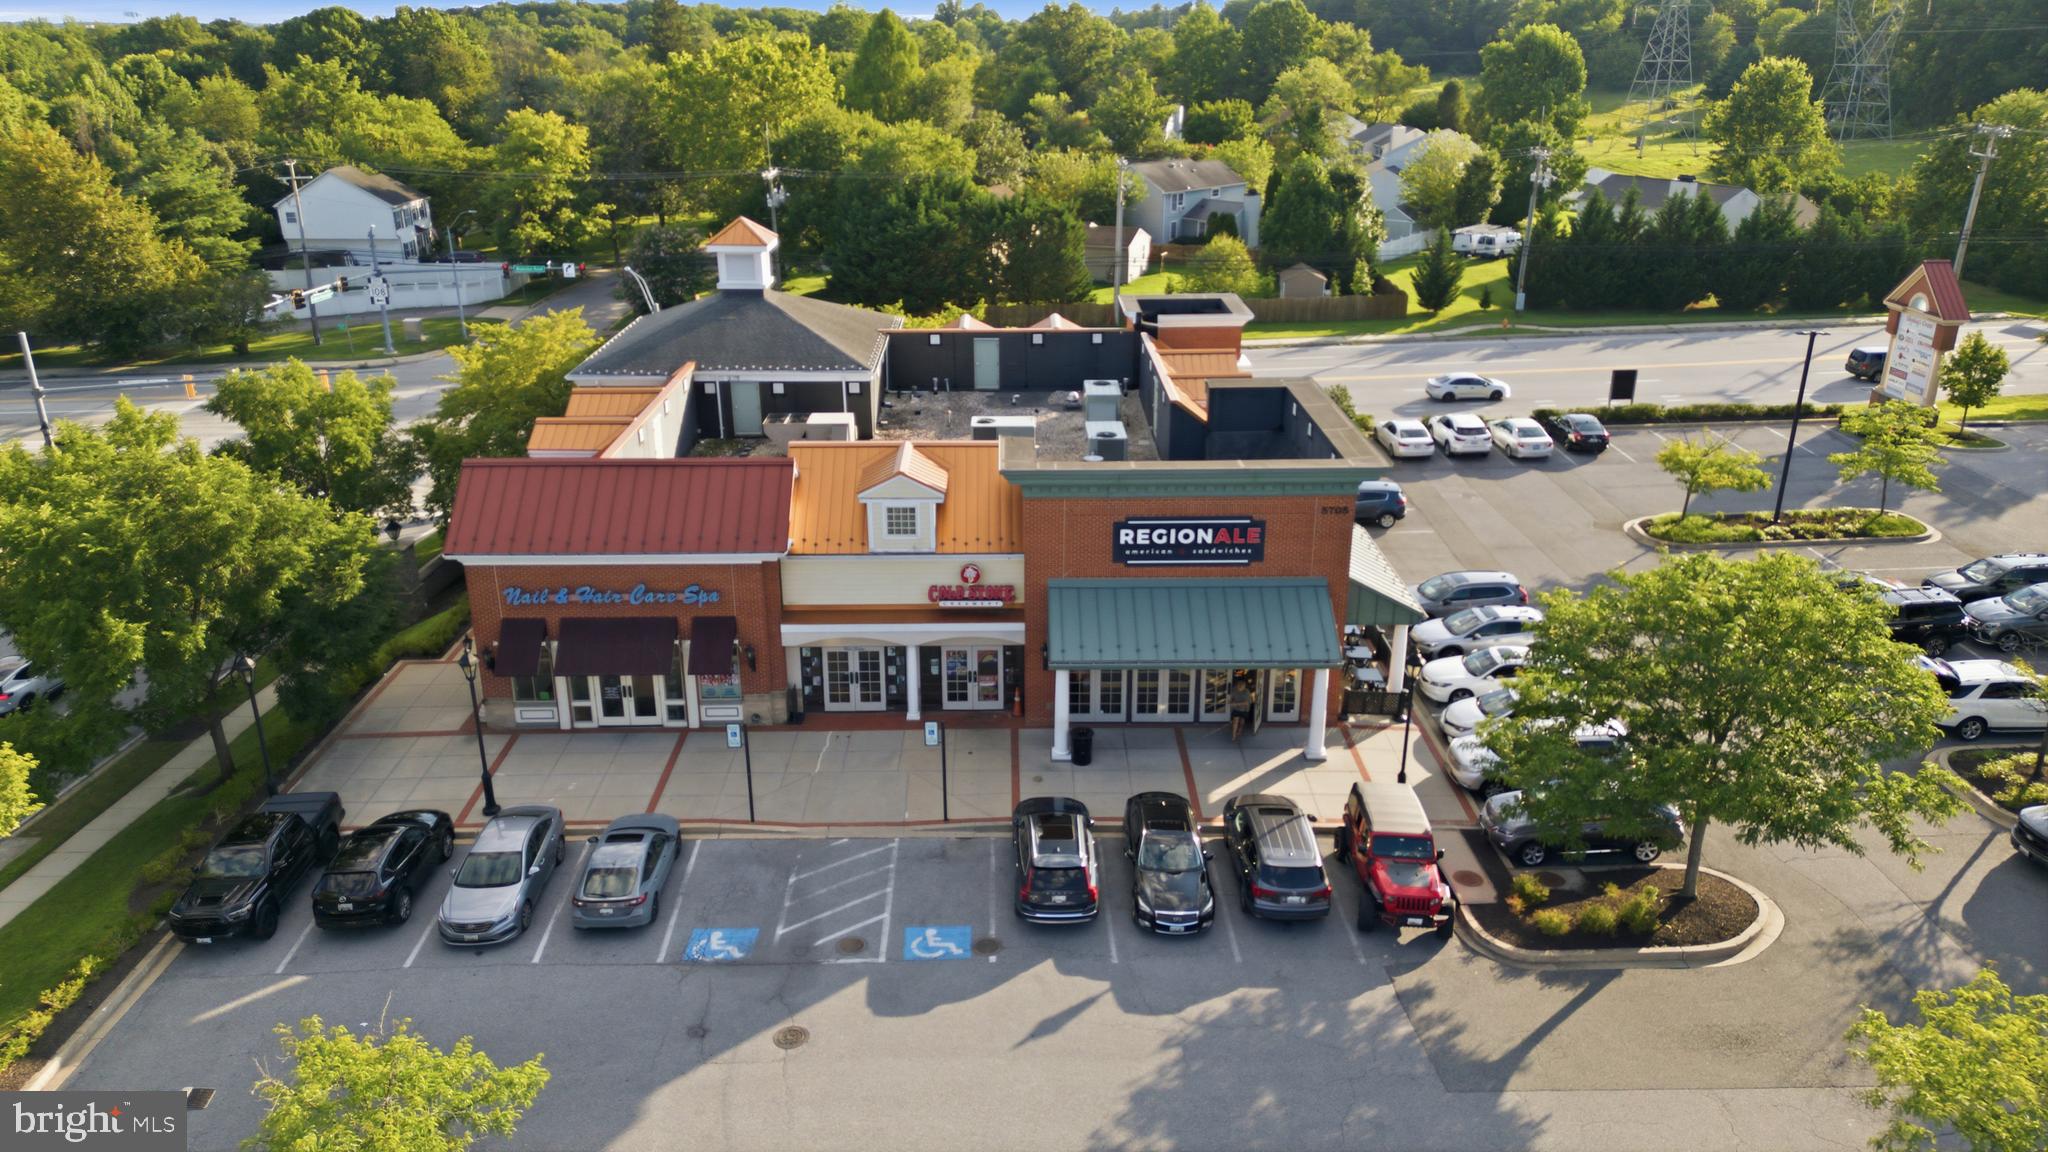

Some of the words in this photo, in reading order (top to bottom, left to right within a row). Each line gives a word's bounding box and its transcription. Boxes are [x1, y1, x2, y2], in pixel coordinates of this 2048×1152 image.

[1120, 528, 1261, 544] REGIONALE
[503, 587, 549, 605] Nail
[554, 588, 569, 604] &
[575, 586, 623, 604] Hair
[630, 583, 677, 605] Care
[684, 585, 720, 608] Spa
